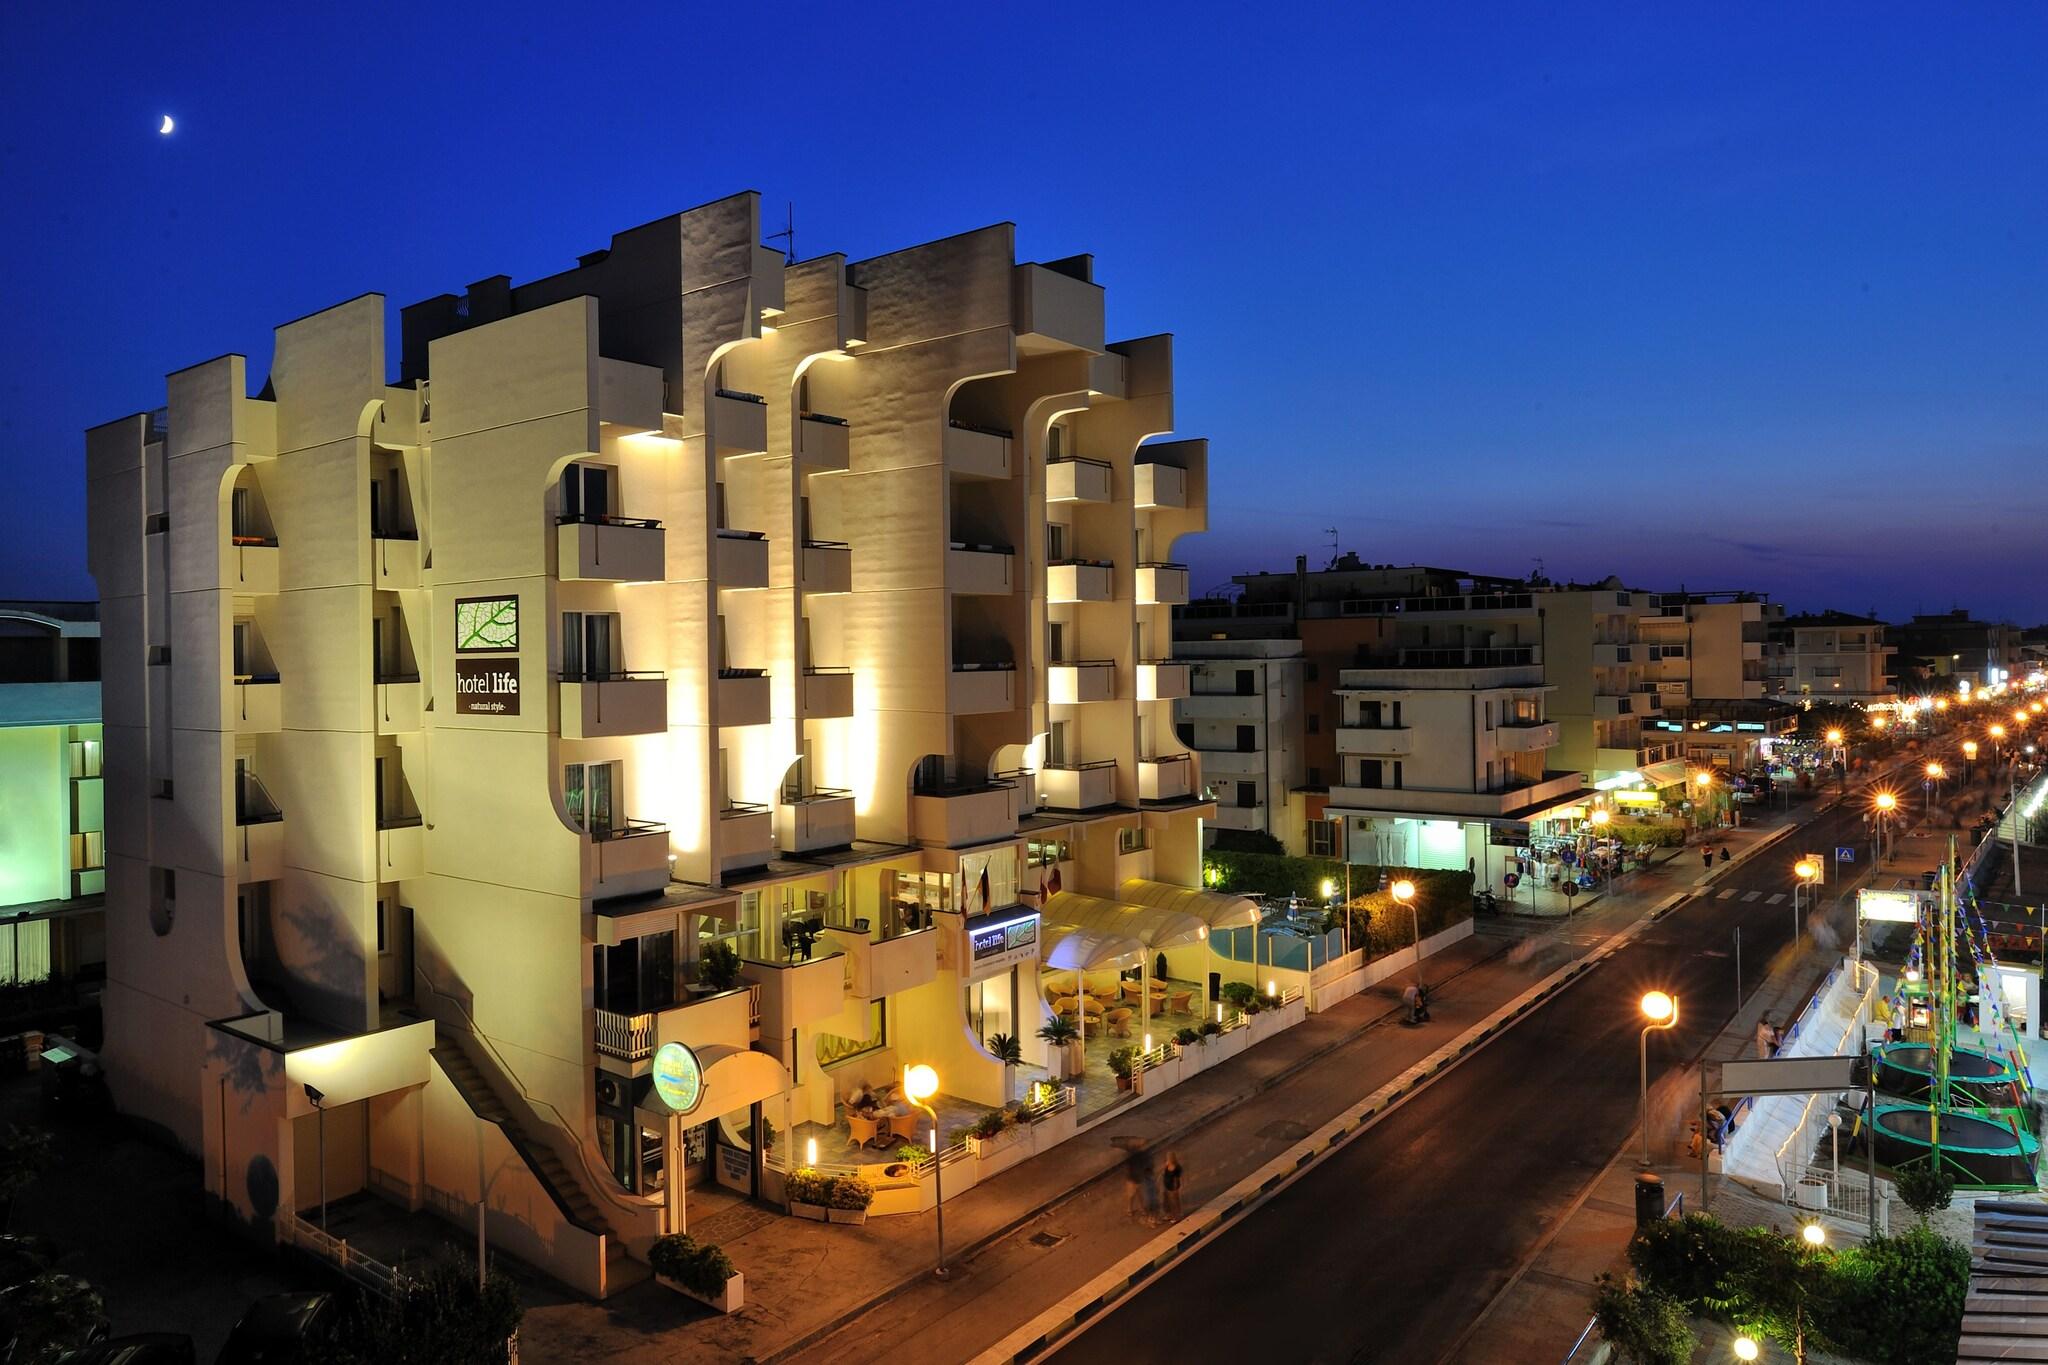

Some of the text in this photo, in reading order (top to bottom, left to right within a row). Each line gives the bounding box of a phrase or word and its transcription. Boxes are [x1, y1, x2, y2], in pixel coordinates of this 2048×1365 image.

[456, 672, 518, 694] hotel life
[975, 933, 1005, 951] hotel life
